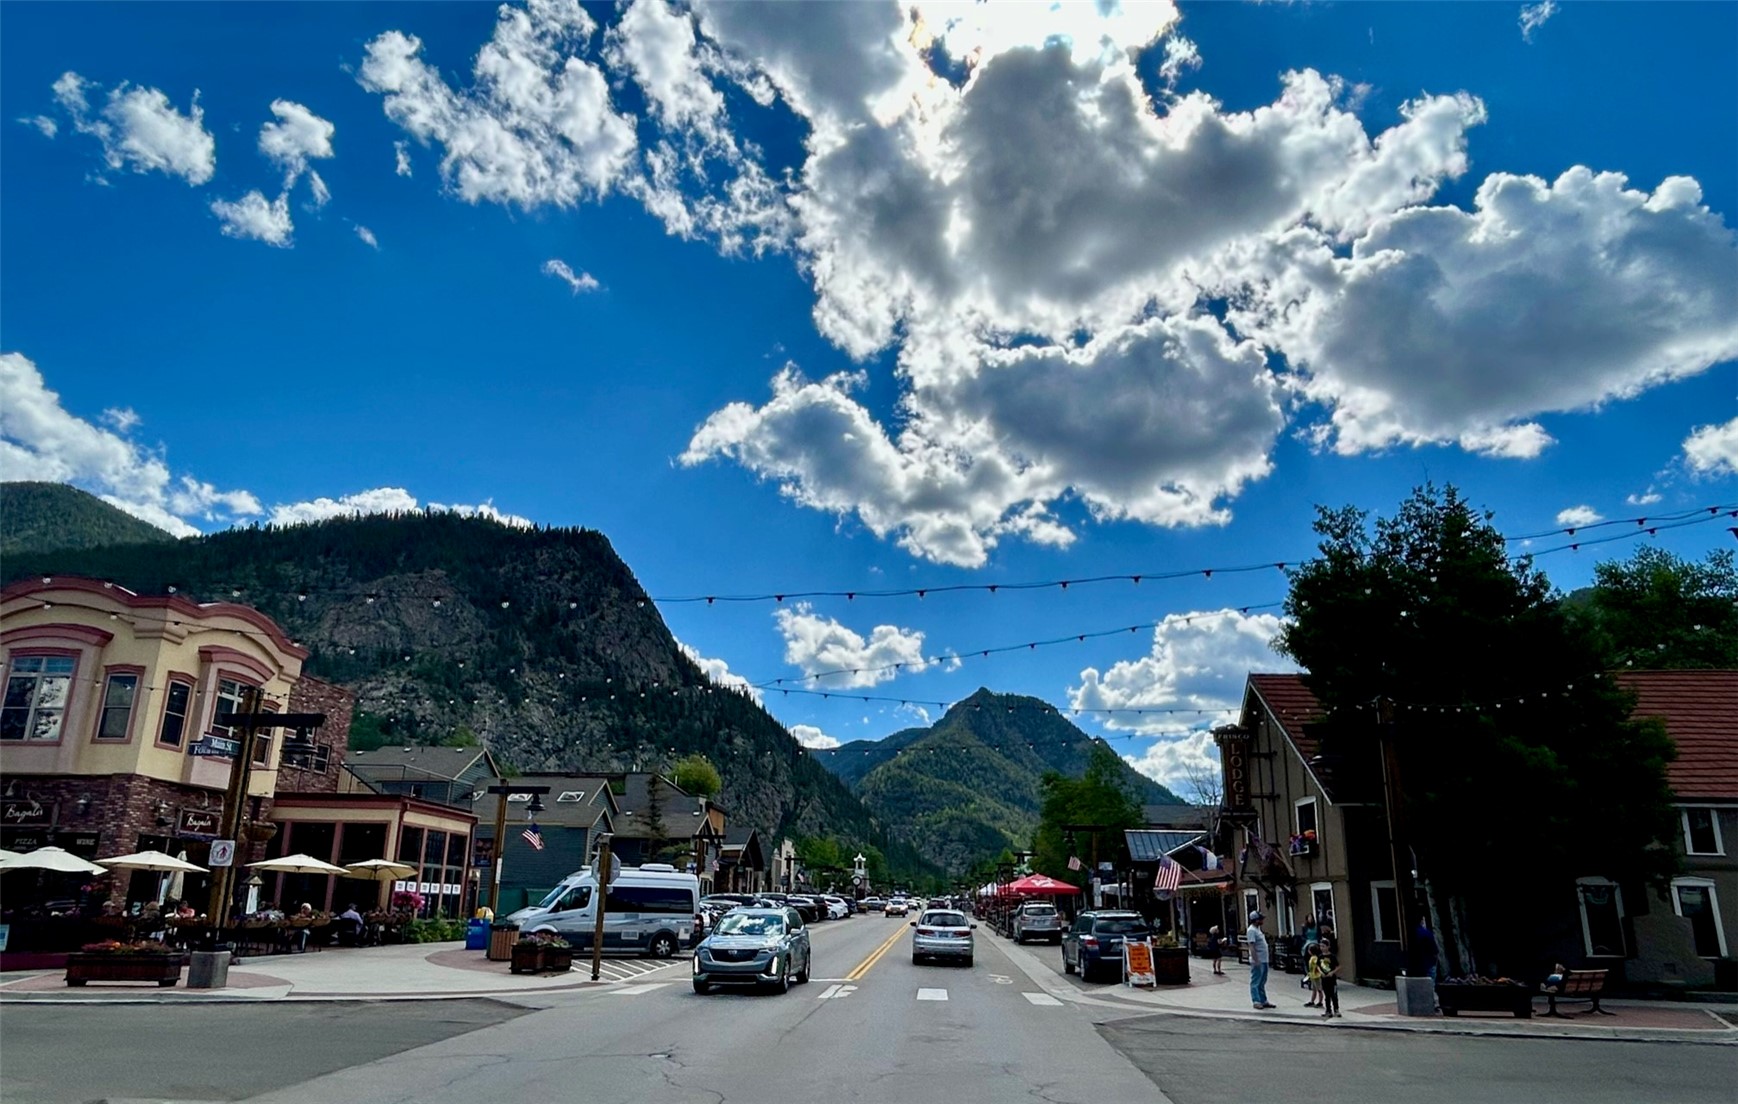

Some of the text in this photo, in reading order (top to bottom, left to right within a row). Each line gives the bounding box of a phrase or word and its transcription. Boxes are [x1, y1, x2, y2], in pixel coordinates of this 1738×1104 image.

[210, 738, 233, 751] Main St
[1230, 743, 1245, 806] LODGE
[76, 838, 96, 846] WINE
